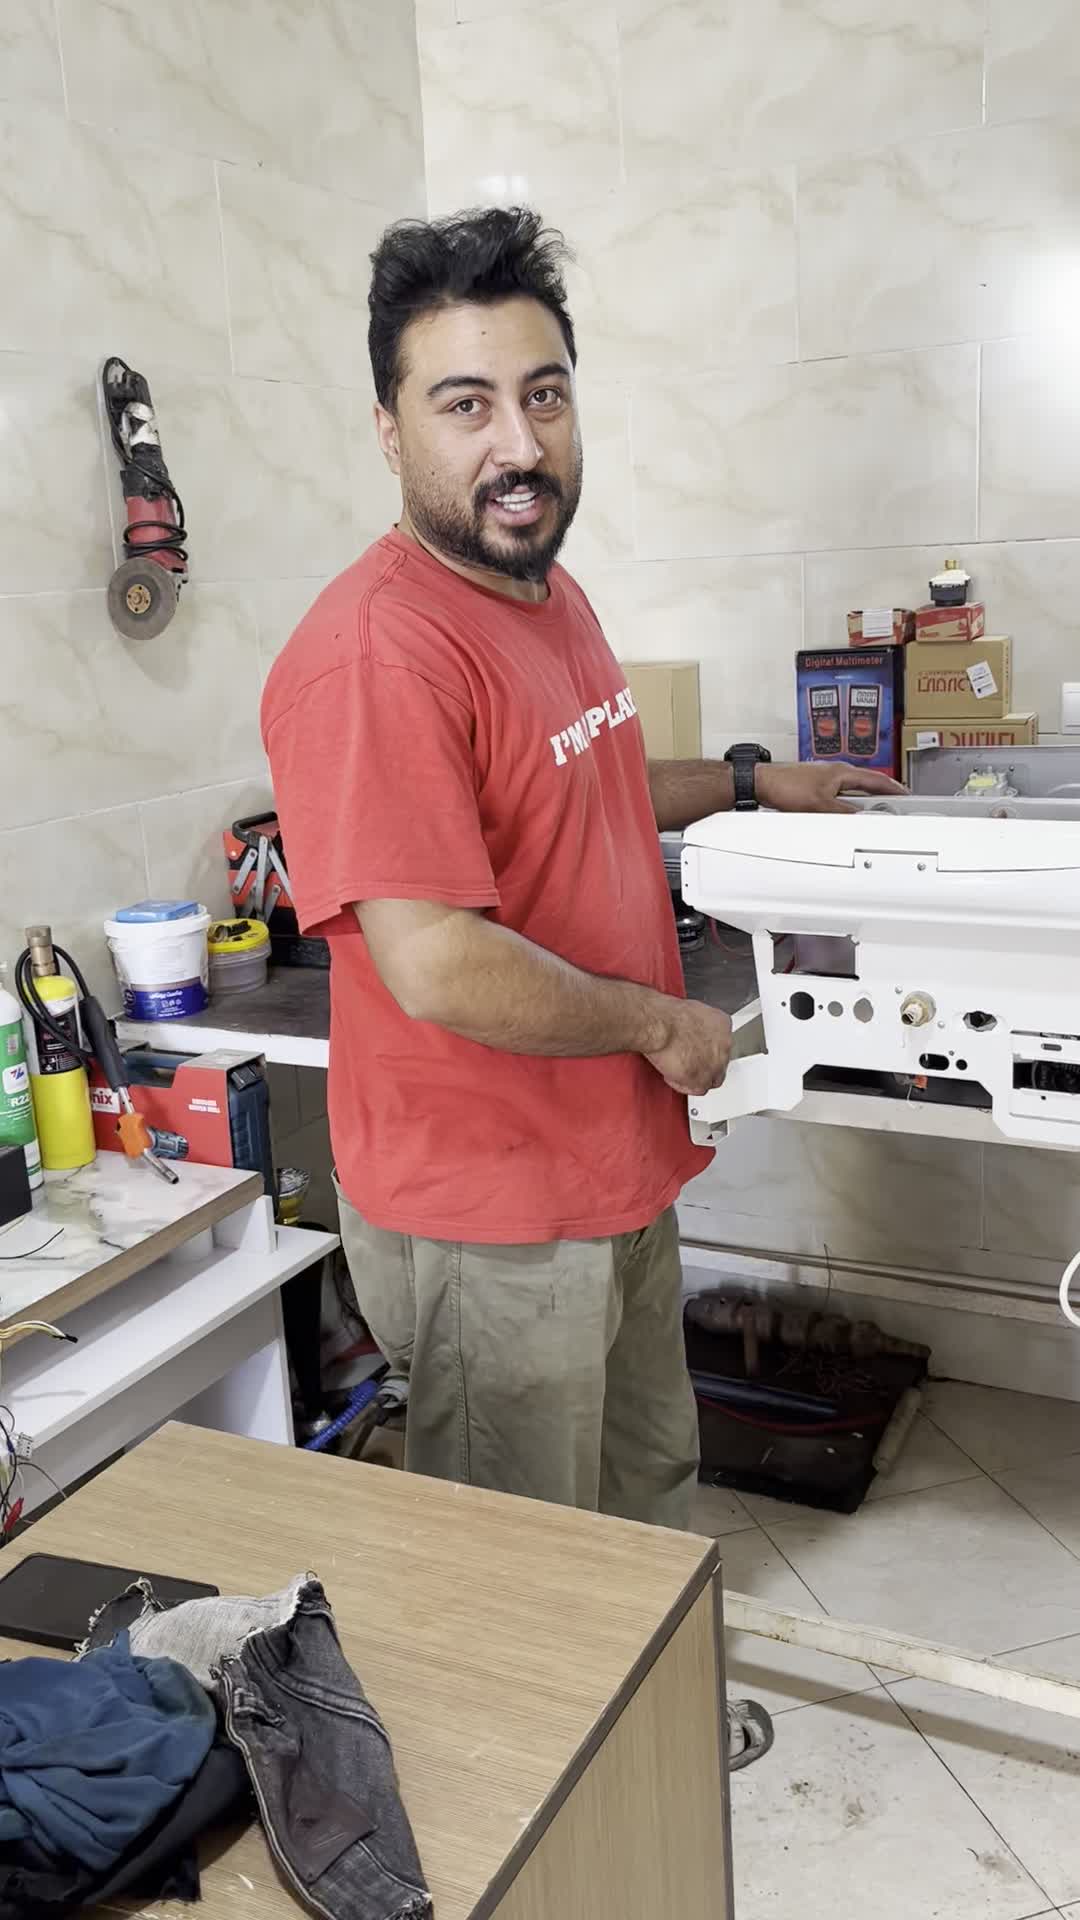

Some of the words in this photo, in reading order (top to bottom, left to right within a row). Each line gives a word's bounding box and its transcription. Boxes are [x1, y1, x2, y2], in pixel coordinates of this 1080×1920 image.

[805, 656, 833, 669] Digital
[835, 655, 883, 666] Multimeter
[92, 1090, 113, 1105] nix
